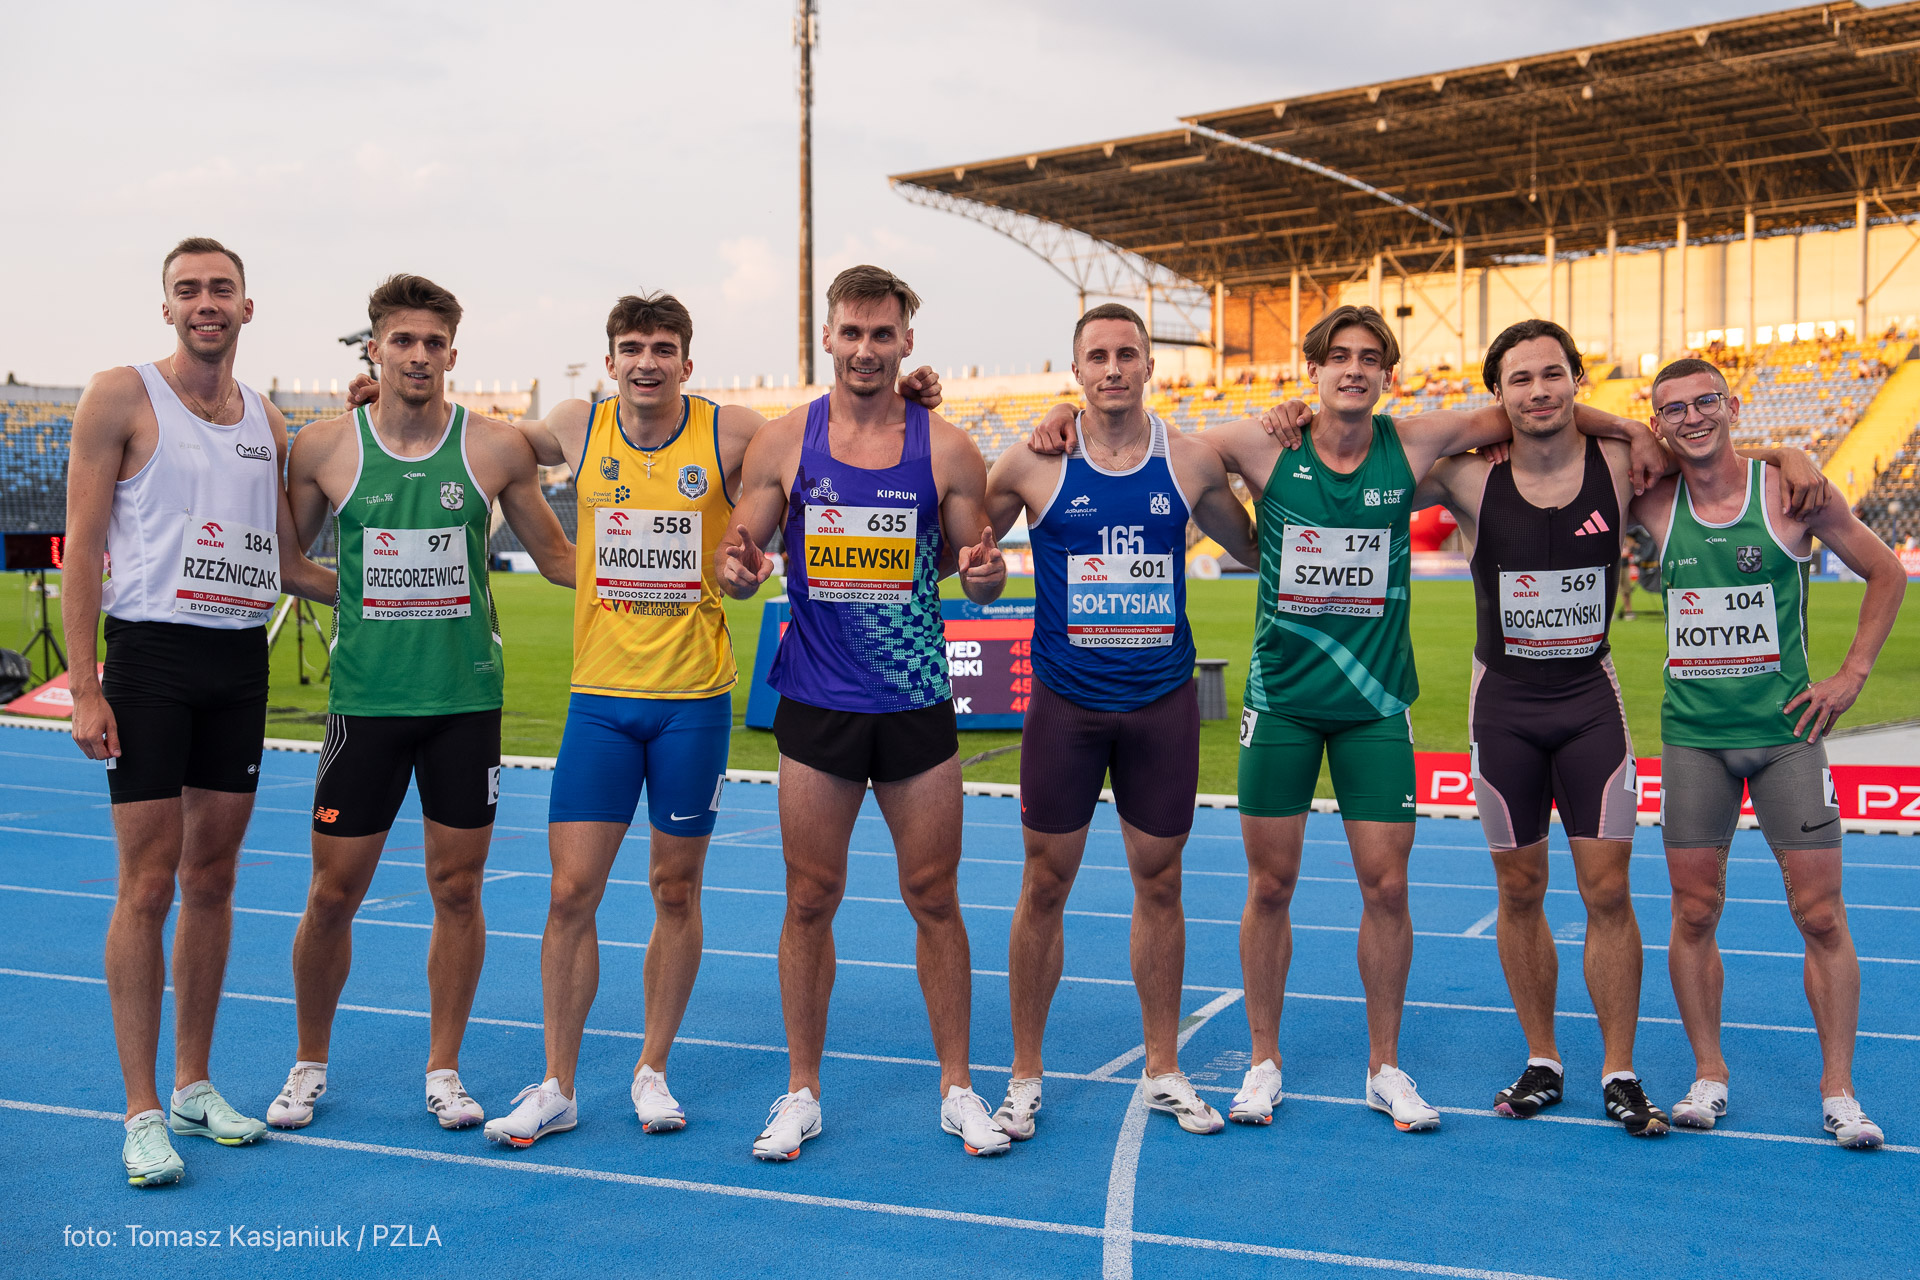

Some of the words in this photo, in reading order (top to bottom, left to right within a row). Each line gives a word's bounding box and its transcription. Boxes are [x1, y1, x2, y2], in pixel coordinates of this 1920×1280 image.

[689, 474, 696, 482] S
[1293, 472, 1313, 481] erima
[877, 489, 917, 501] KIPRUN
[652, 517, 692, 535] 558
[867, 514, 907, 532] 635
[197, 539, 224, 548] ORLEN
[245, 533, 272, 554] 184
[428, 534, 451, 553] 97
[1098, 525, 1145, 555] 165
[1345, 534, 1380, 552] 174
[599, 546, 696, 570] KAROLEWSKI
[809, 546, 909, 569] ZALEWSKI
[1678, 557, 1698, 566] UMCS
[183, 557, 278, 590] RZEŹNICZAK
[366, 565, 465, 588] GRZEGORZEWICZ
[1130, 560, 1165, 578] 601
[1294, 564, 1374, 586] SZWED
[1561, 573, 1596, 593] 569
[206, 594, 220, 602] PZLA
[221, 596, 253, 606] Mistrzostwa
[608, 590, 662, 599] BYDGOSZCZ
[819, 591, 875, 600] BYDGOSZCZ
[1072, 593, 1171, 614] SOŁTYSIAK
[1724, 590, 1764, 610] 104
[190, 603, 246, 617] BYDGOSZCZ
[375, 609, 433, 617] BYDGOSZCZ
[435, 608, 458, 617] 2024
[632, 606, 689, 617] WIELKOPOLSKI
[1291, 605, 1346, 613] BYDGOSZCZ
[1504, 603, 1601, 628] BOGACZYŃSKI
[1081, 637, 1139, 645] BYDGOSZCZ
[1676, 623, 1770, 647] KOTYRA
[1517, 647, 1572, 656] BYDGOSZCZ
[1574, 646, 1594, 654] 2024
[1009, 659, 1033, 675] 45
[1682, 668, 1740, 677] BYDGOSZCZ
[1742, 665, 1766, 675] 2024
[1010, 678, 1032, 694] 45
[1240, 709, 1251, 741] 5
[1431, 771, 1476, 800] P
